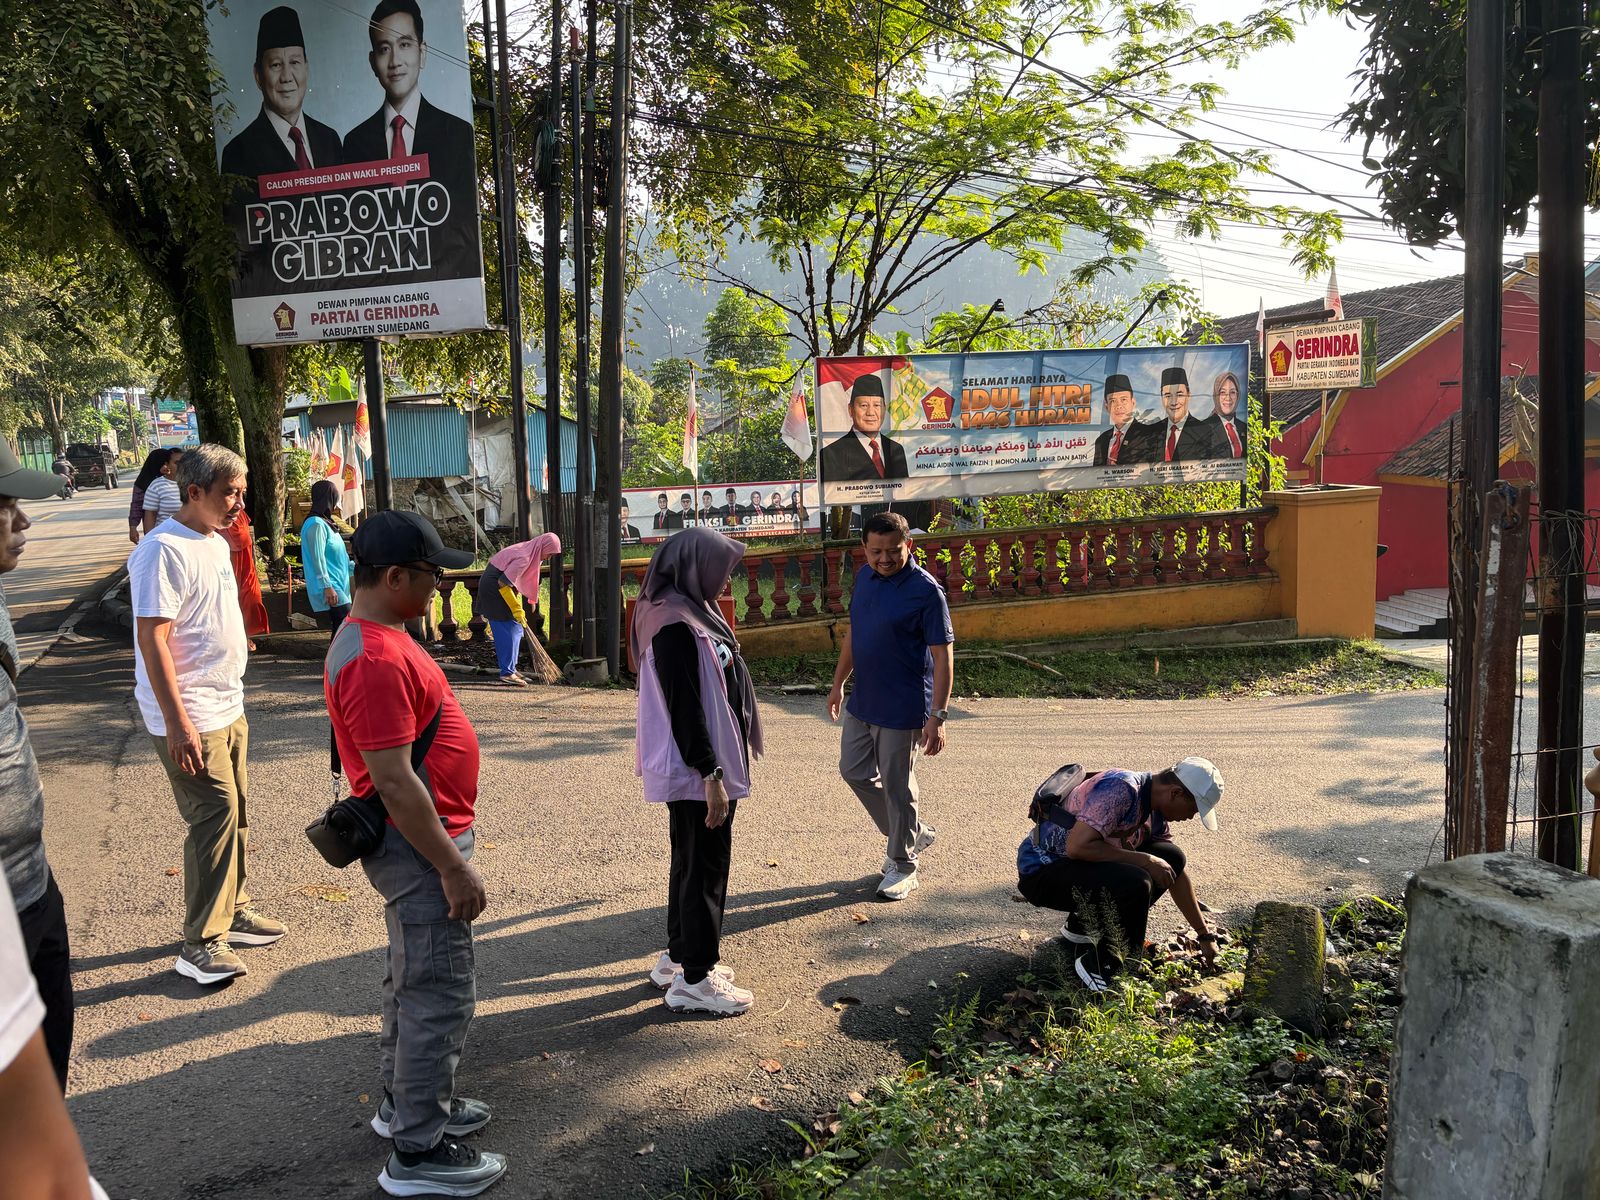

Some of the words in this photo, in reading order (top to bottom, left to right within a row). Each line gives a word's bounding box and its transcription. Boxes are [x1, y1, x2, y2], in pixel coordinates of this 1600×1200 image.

[266, 179, 293, 190] CALON
[294, 174, 333, 187] PRESIDEN
[334, 172, 351, 182] DAN
[352, 168, 379, 180] WAKIL
[380, 162, 421, 176] PRESIDEN
[246, 182, 450, 244] PRABOWO
[272, 227, 432, 283] GIBRAN
[318, 300, 348, 310] DEWAN
[350, 295, 391, 307] PIMPINAN
[392, 292, 430, 304] CABANG
[310, 309, 360, 325] PARTAI
[364, 302, 440, 322] GERINDRA
[322, 326, 376, 337] KABUPATEN
[377, 320, 430, 334] SUMEDANG
[1296, 328, 1313, 337] DEWAN
[1314, 326, 1338, 335] PIMPINAN
[1338, 322, 1360, 332] CABANG
[1296, 333, 1359, 360] GERINDRA
[1328, 359, 1349, 367] INDONESIA
[962, 377, 1008, 387] SELAMAT
[1011, 375, 1036, 384] HARI
[1040, 374, 1066, 383] RAYA
[1297, 371, 1327, 380] KABUPATEN
[1328, 369, 1359, 379] SUMEDANG
[961, 387, 1024, 412] IDUL
[1030, 384, 1092, 408] FITRI
[961, 411, 1010, 430] 1446
[1015, 407, 1092, 426] HIJRIAH
[683, 518, 723, 528] FRAKSI
[742, 514, 800, 525] GERINDRA
